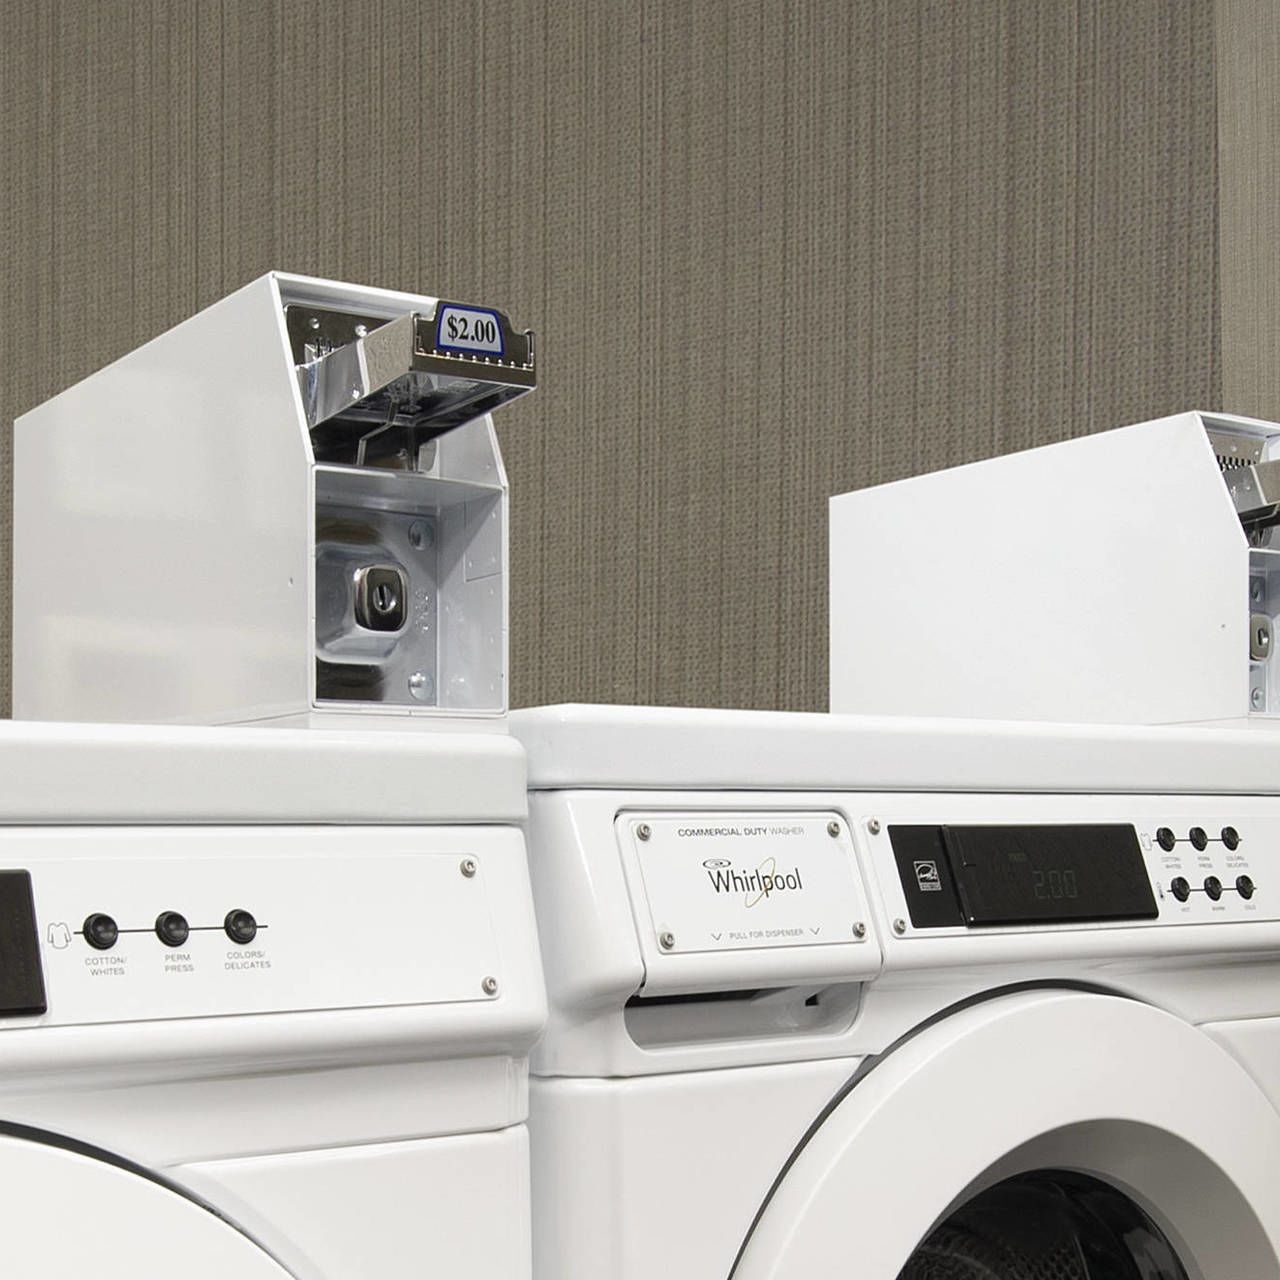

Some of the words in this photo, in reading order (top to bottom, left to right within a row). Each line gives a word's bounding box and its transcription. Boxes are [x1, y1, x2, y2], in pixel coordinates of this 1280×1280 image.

[447, 314, 496, 344] $2.00
[677, 828, 742, 837] COMMERCIAL
[744, 827, 767, 836] DUTY
[707, 868, 803, 898] Whirlpool
[165, 954, 191, 962] PERM
[165, 964, 194, 973] PRESS
[224, 961, 272, 971] DELICATES
[90, 967, 125, 977] WHITES
